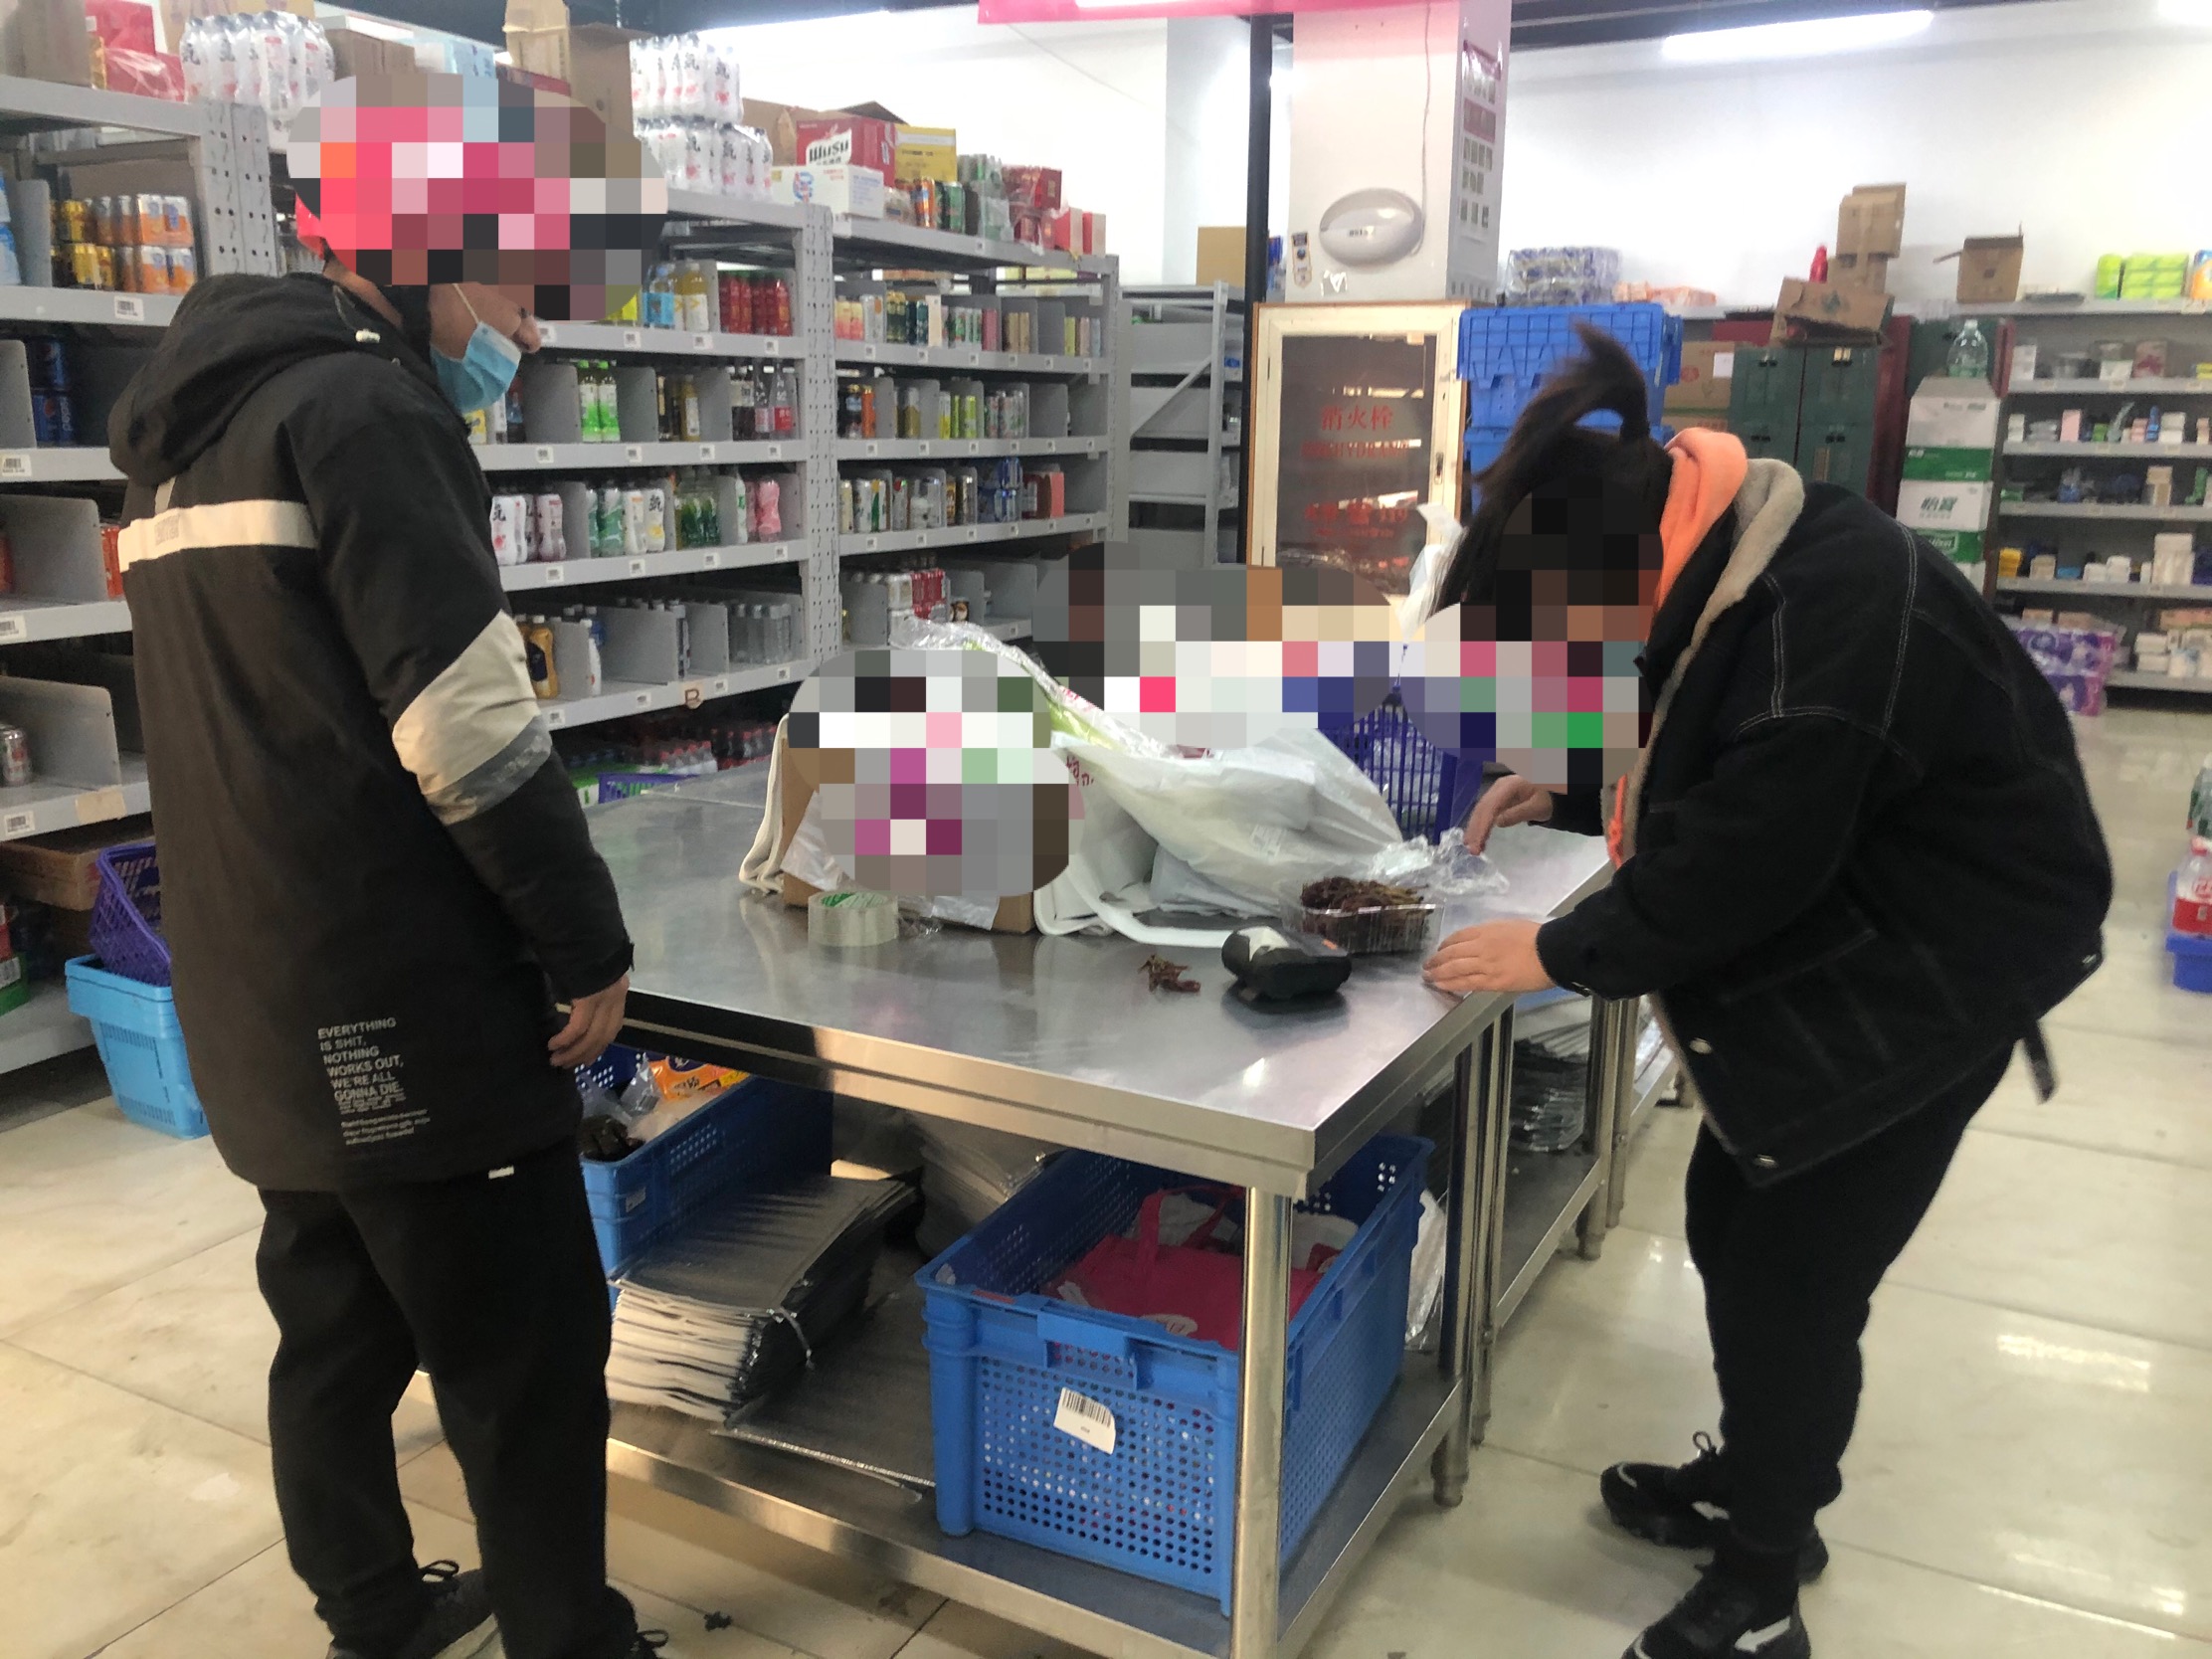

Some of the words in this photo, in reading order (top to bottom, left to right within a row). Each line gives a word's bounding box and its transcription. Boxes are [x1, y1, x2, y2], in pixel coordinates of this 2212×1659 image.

[1320, 404, 1393, 431] 消火栓
[317, 1016, 397, 1040] EVERYTHING
[320, 1040, 332, 1051] IS
[323, 1045, 380, 1065] NOTHING
[326, 1061, 372, 1077] WORKS
[374, 1054, 404, 1070] OUT,
[372, 1070, 396, 1083] ALL
[334, 1086, 378, 1102] GONNA
